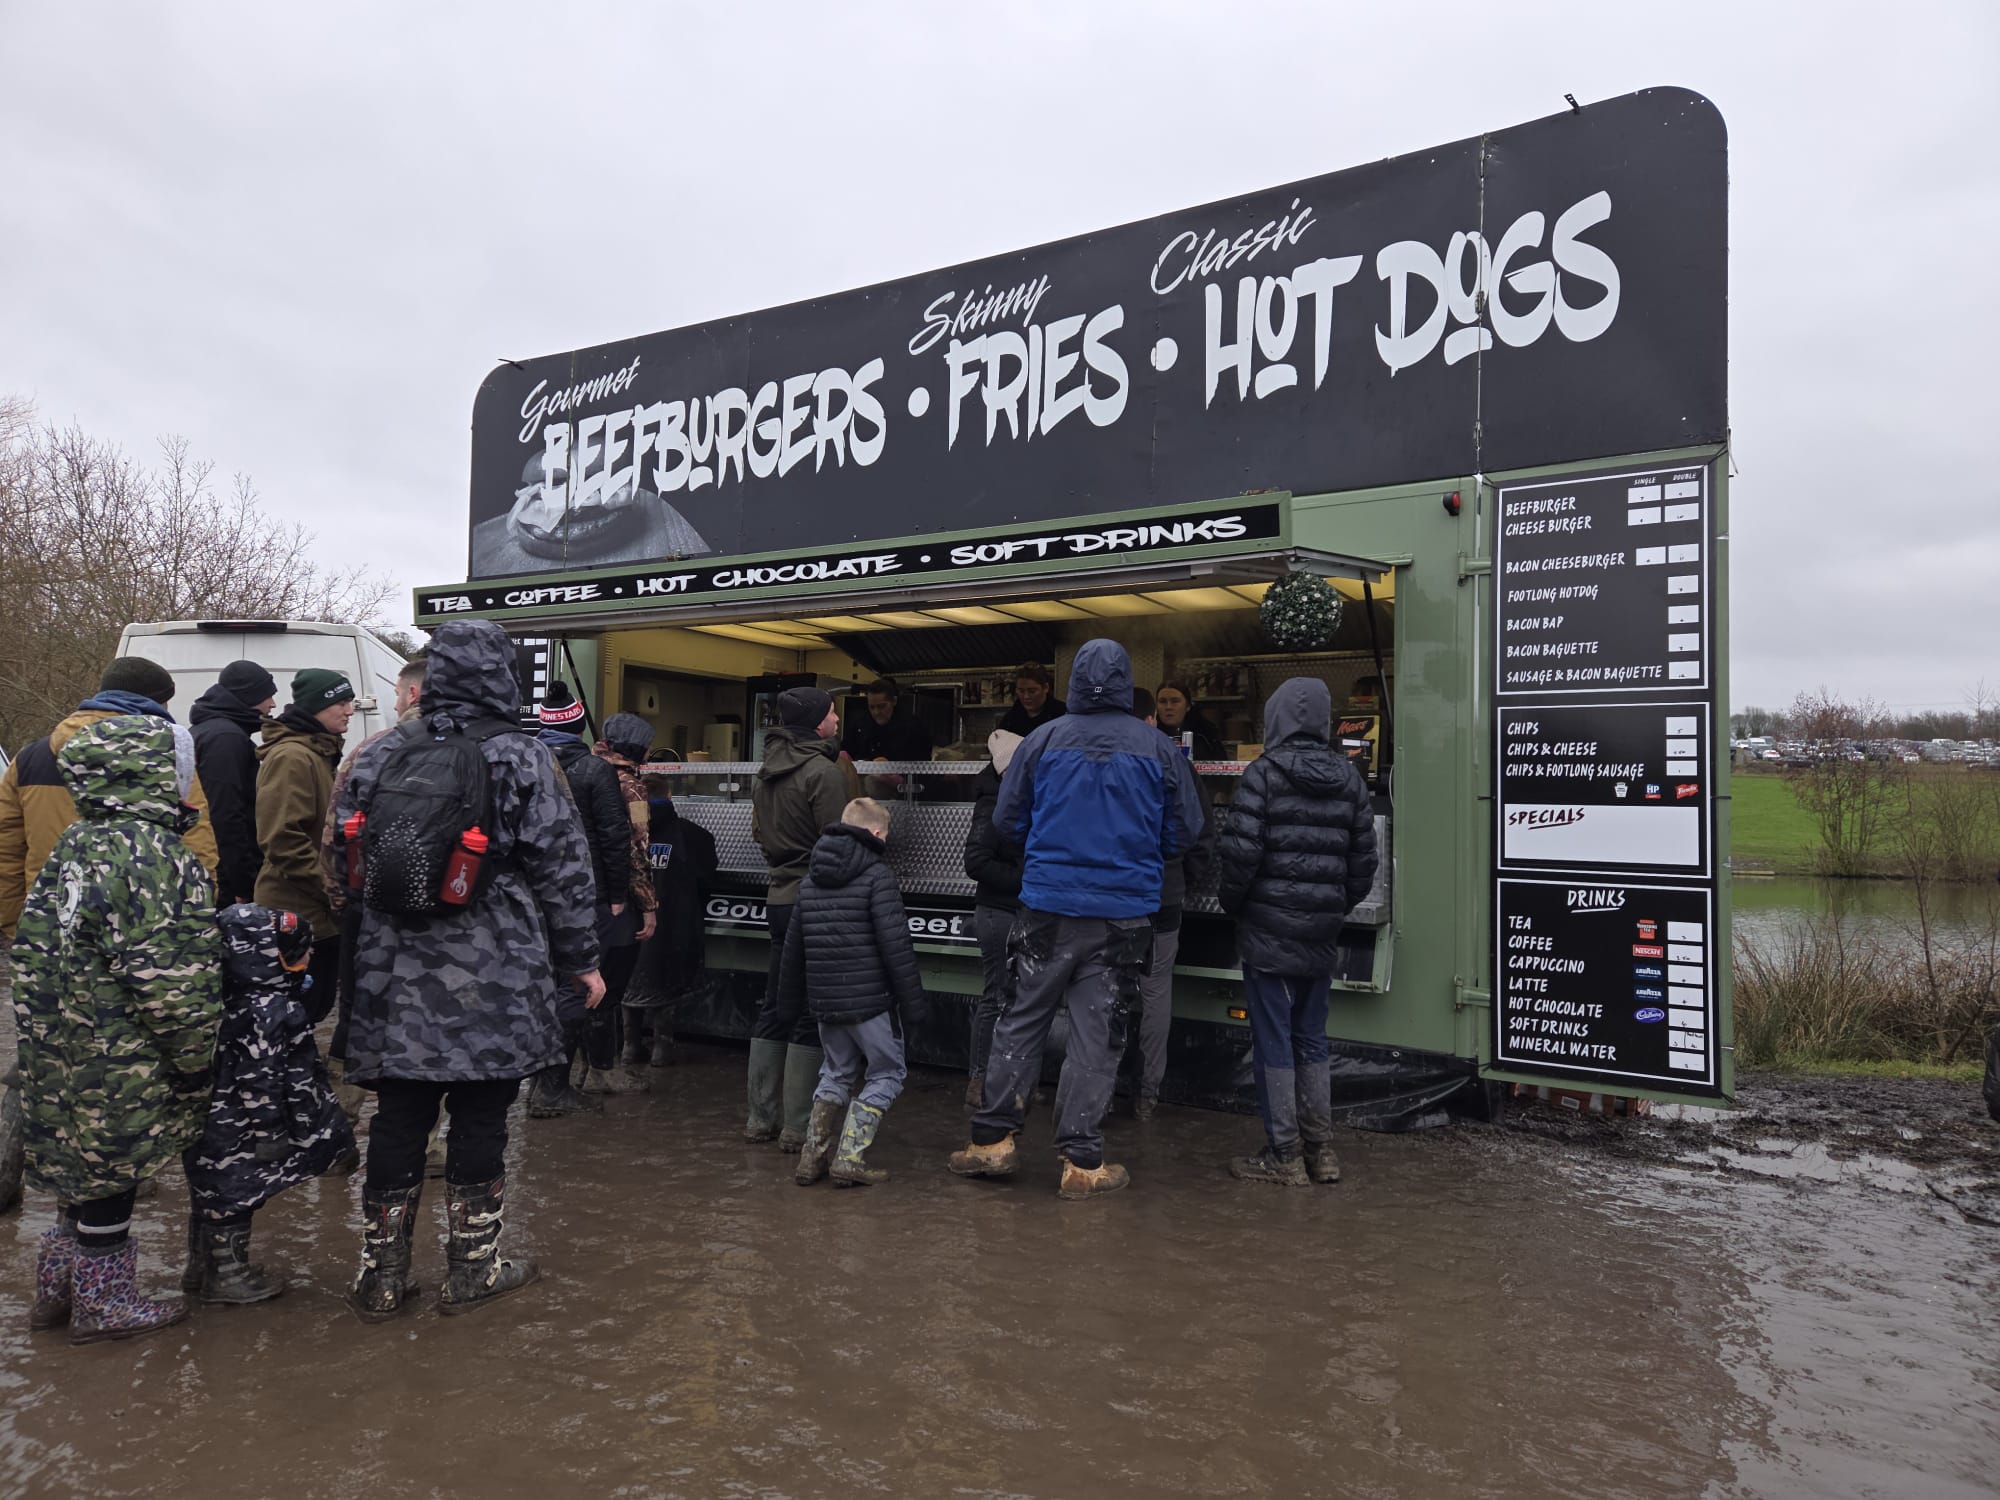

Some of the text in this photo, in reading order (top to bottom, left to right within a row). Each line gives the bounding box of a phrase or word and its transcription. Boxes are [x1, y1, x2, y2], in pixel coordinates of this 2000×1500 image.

[1151, 197, 1318, 294] Classic
[908, 272, 1052, 357] Skinny
[539, 190, 1621, 511] BEEFBURGERS FRIES HOT DOGS
[518, 355, 640, 443] Gourmet
[1634, 477, 1656, 485] SINGLE
[1506, 496, 1576, 517] BEEFBURGER
[1506, 515, 1592, 536] CHEESE BURGER
[428, 515, 1248, 612] TEA COFFEE HOT CHOCOLATE SOFT DRINKS
[1506, 552, 1625, 574] BACON CHEESEBURGER
[1508, 584, 1599, 603] FOOTLONG HOTDOG
[1506, 616, 1564, 632] BACON BAP
[1507, 641, 1599, 659] BACON BAGUETTE
[1507, 665, 1662, 686] SAUSAGE & BACON BAGUETTE
[1507, 722, 1539, 735] CHIPS
[1507, 742, 1597, 756] CHIPS & CHEESE
[1506, 764, 1644, 781] CHIPS & FOOTLONG SAUSAGE
[1646, 784, 1660, 793] HP
[1508, 808, 1585, 826] SPECIALS
[1567, 890, 1626, 907] DRINKS
[1508, 916, 1531, 930] TEA
[1508, 935, 1553, 950] COFFEE
[1508, 955, 1585, 973] CAPPUCCINO
[1509, 976, 1548, 992] LATTE
[1508, 997, 1603, 1018] HOT CHOCOLATE
[1509, 1017, 1589, 1036] SOFT DRINKS
[1509, 1036, 1616, 1061] MINERAL WATER
